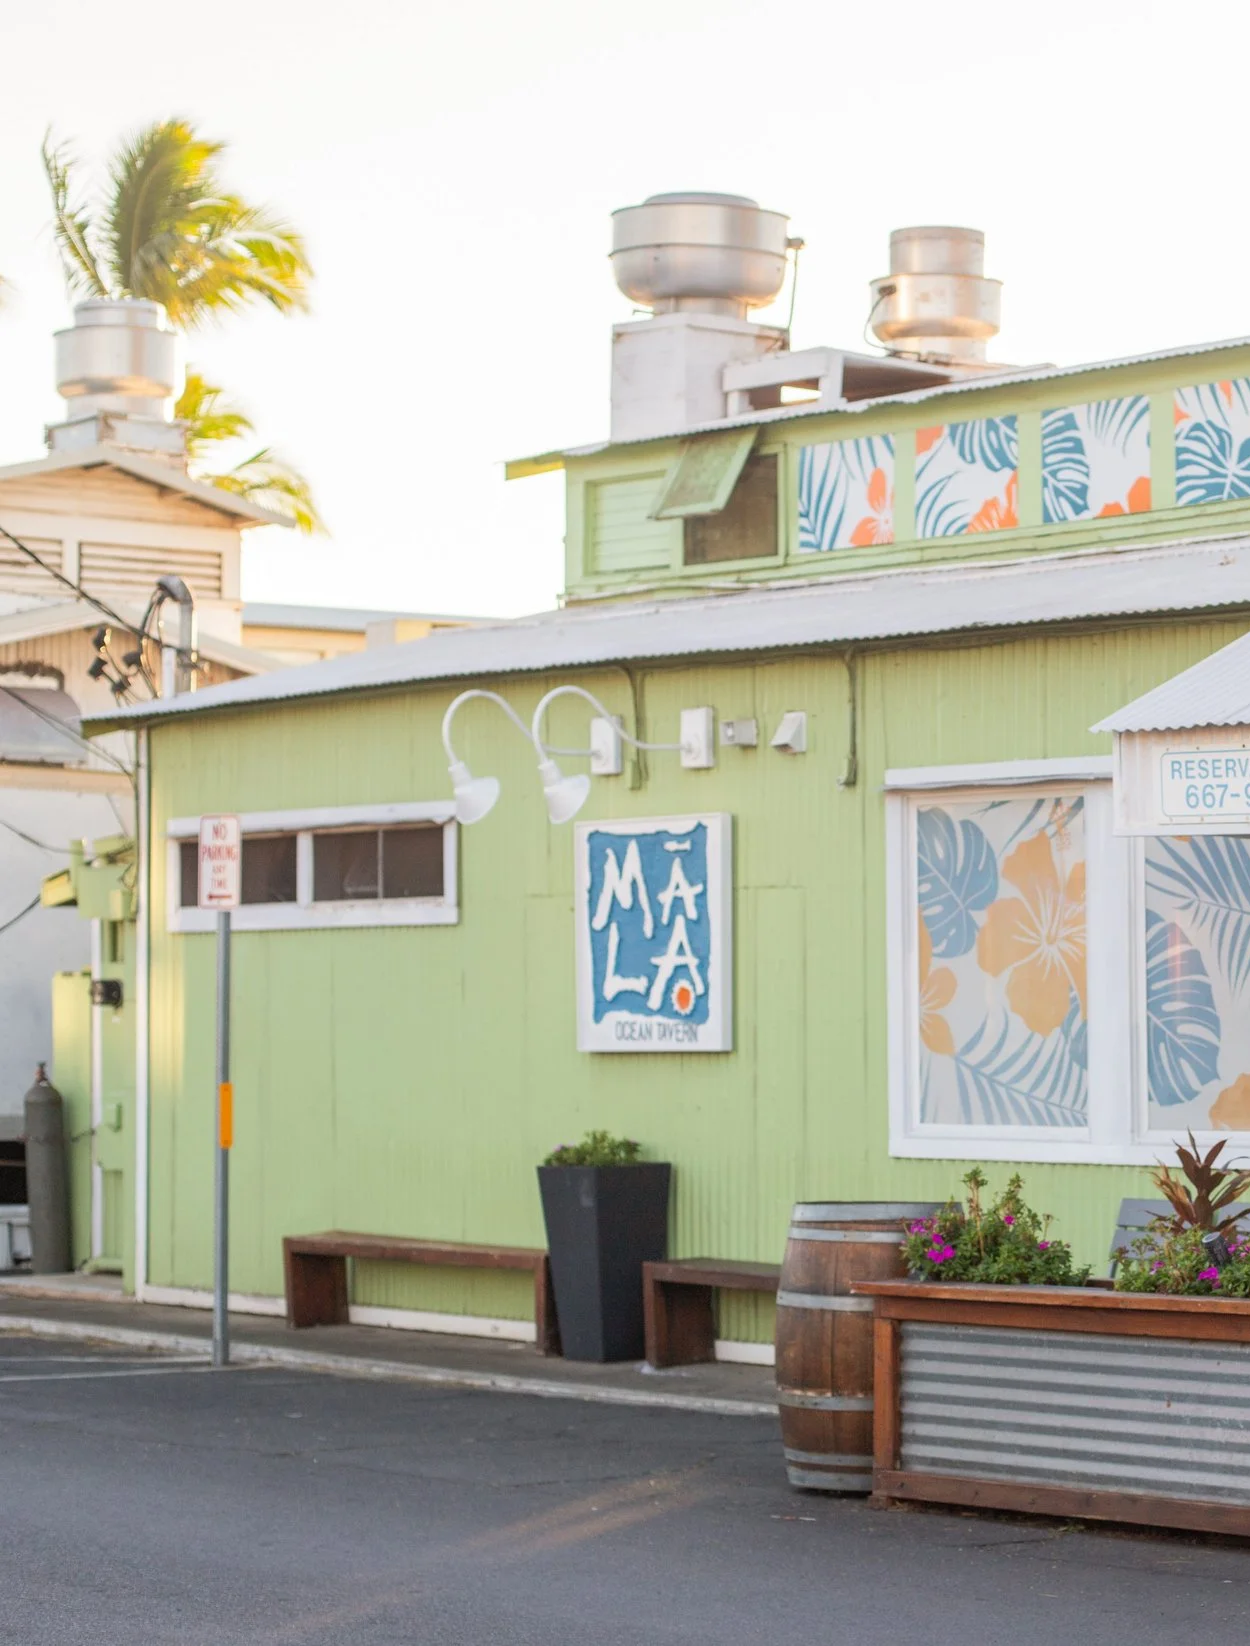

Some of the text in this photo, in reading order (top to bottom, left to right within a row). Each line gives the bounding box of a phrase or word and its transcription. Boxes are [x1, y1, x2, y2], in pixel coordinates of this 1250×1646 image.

[212, 824, 227, 840] NO
[202, 845, 238, 861] PARKING
[615, 1022, 698, 1042] OCEAN TAVERN
